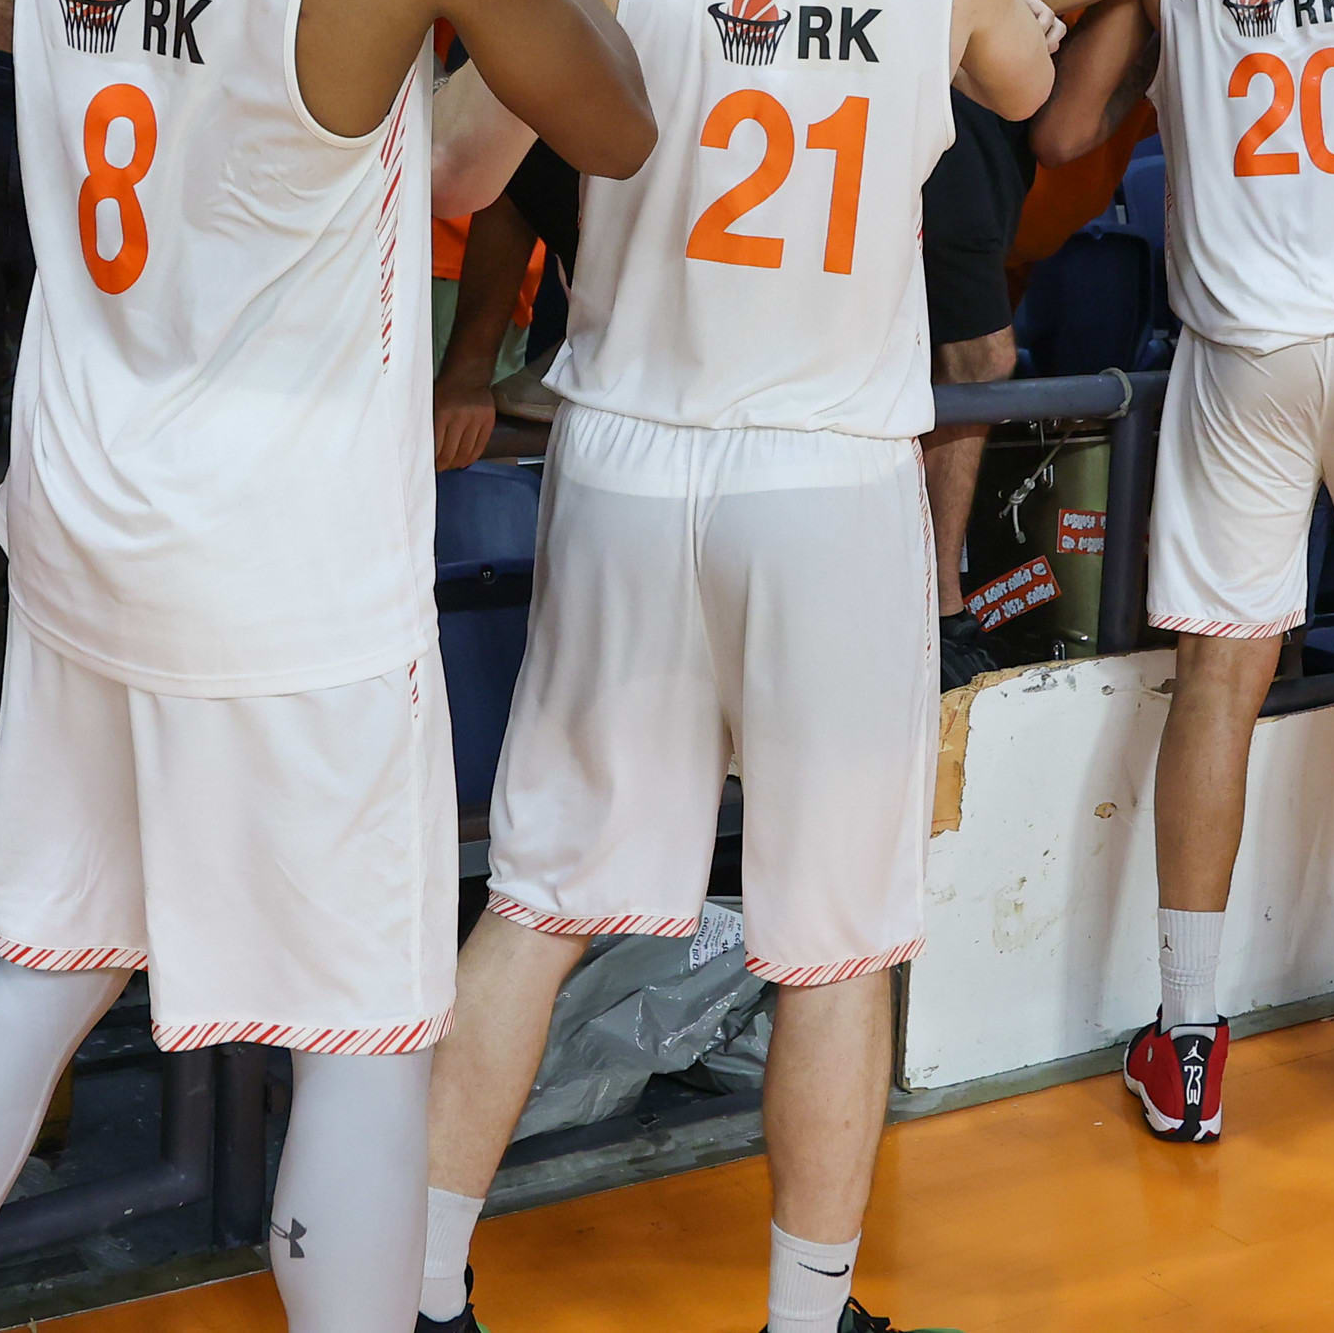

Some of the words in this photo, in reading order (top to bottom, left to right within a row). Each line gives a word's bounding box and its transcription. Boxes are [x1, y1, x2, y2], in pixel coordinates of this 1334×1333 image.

[797, 5, 882, 63] RK
[78, 84, 157, 295] 8
[686, 89, 870, 275] 21
[1183, 1066, 1203, 1105] 23
